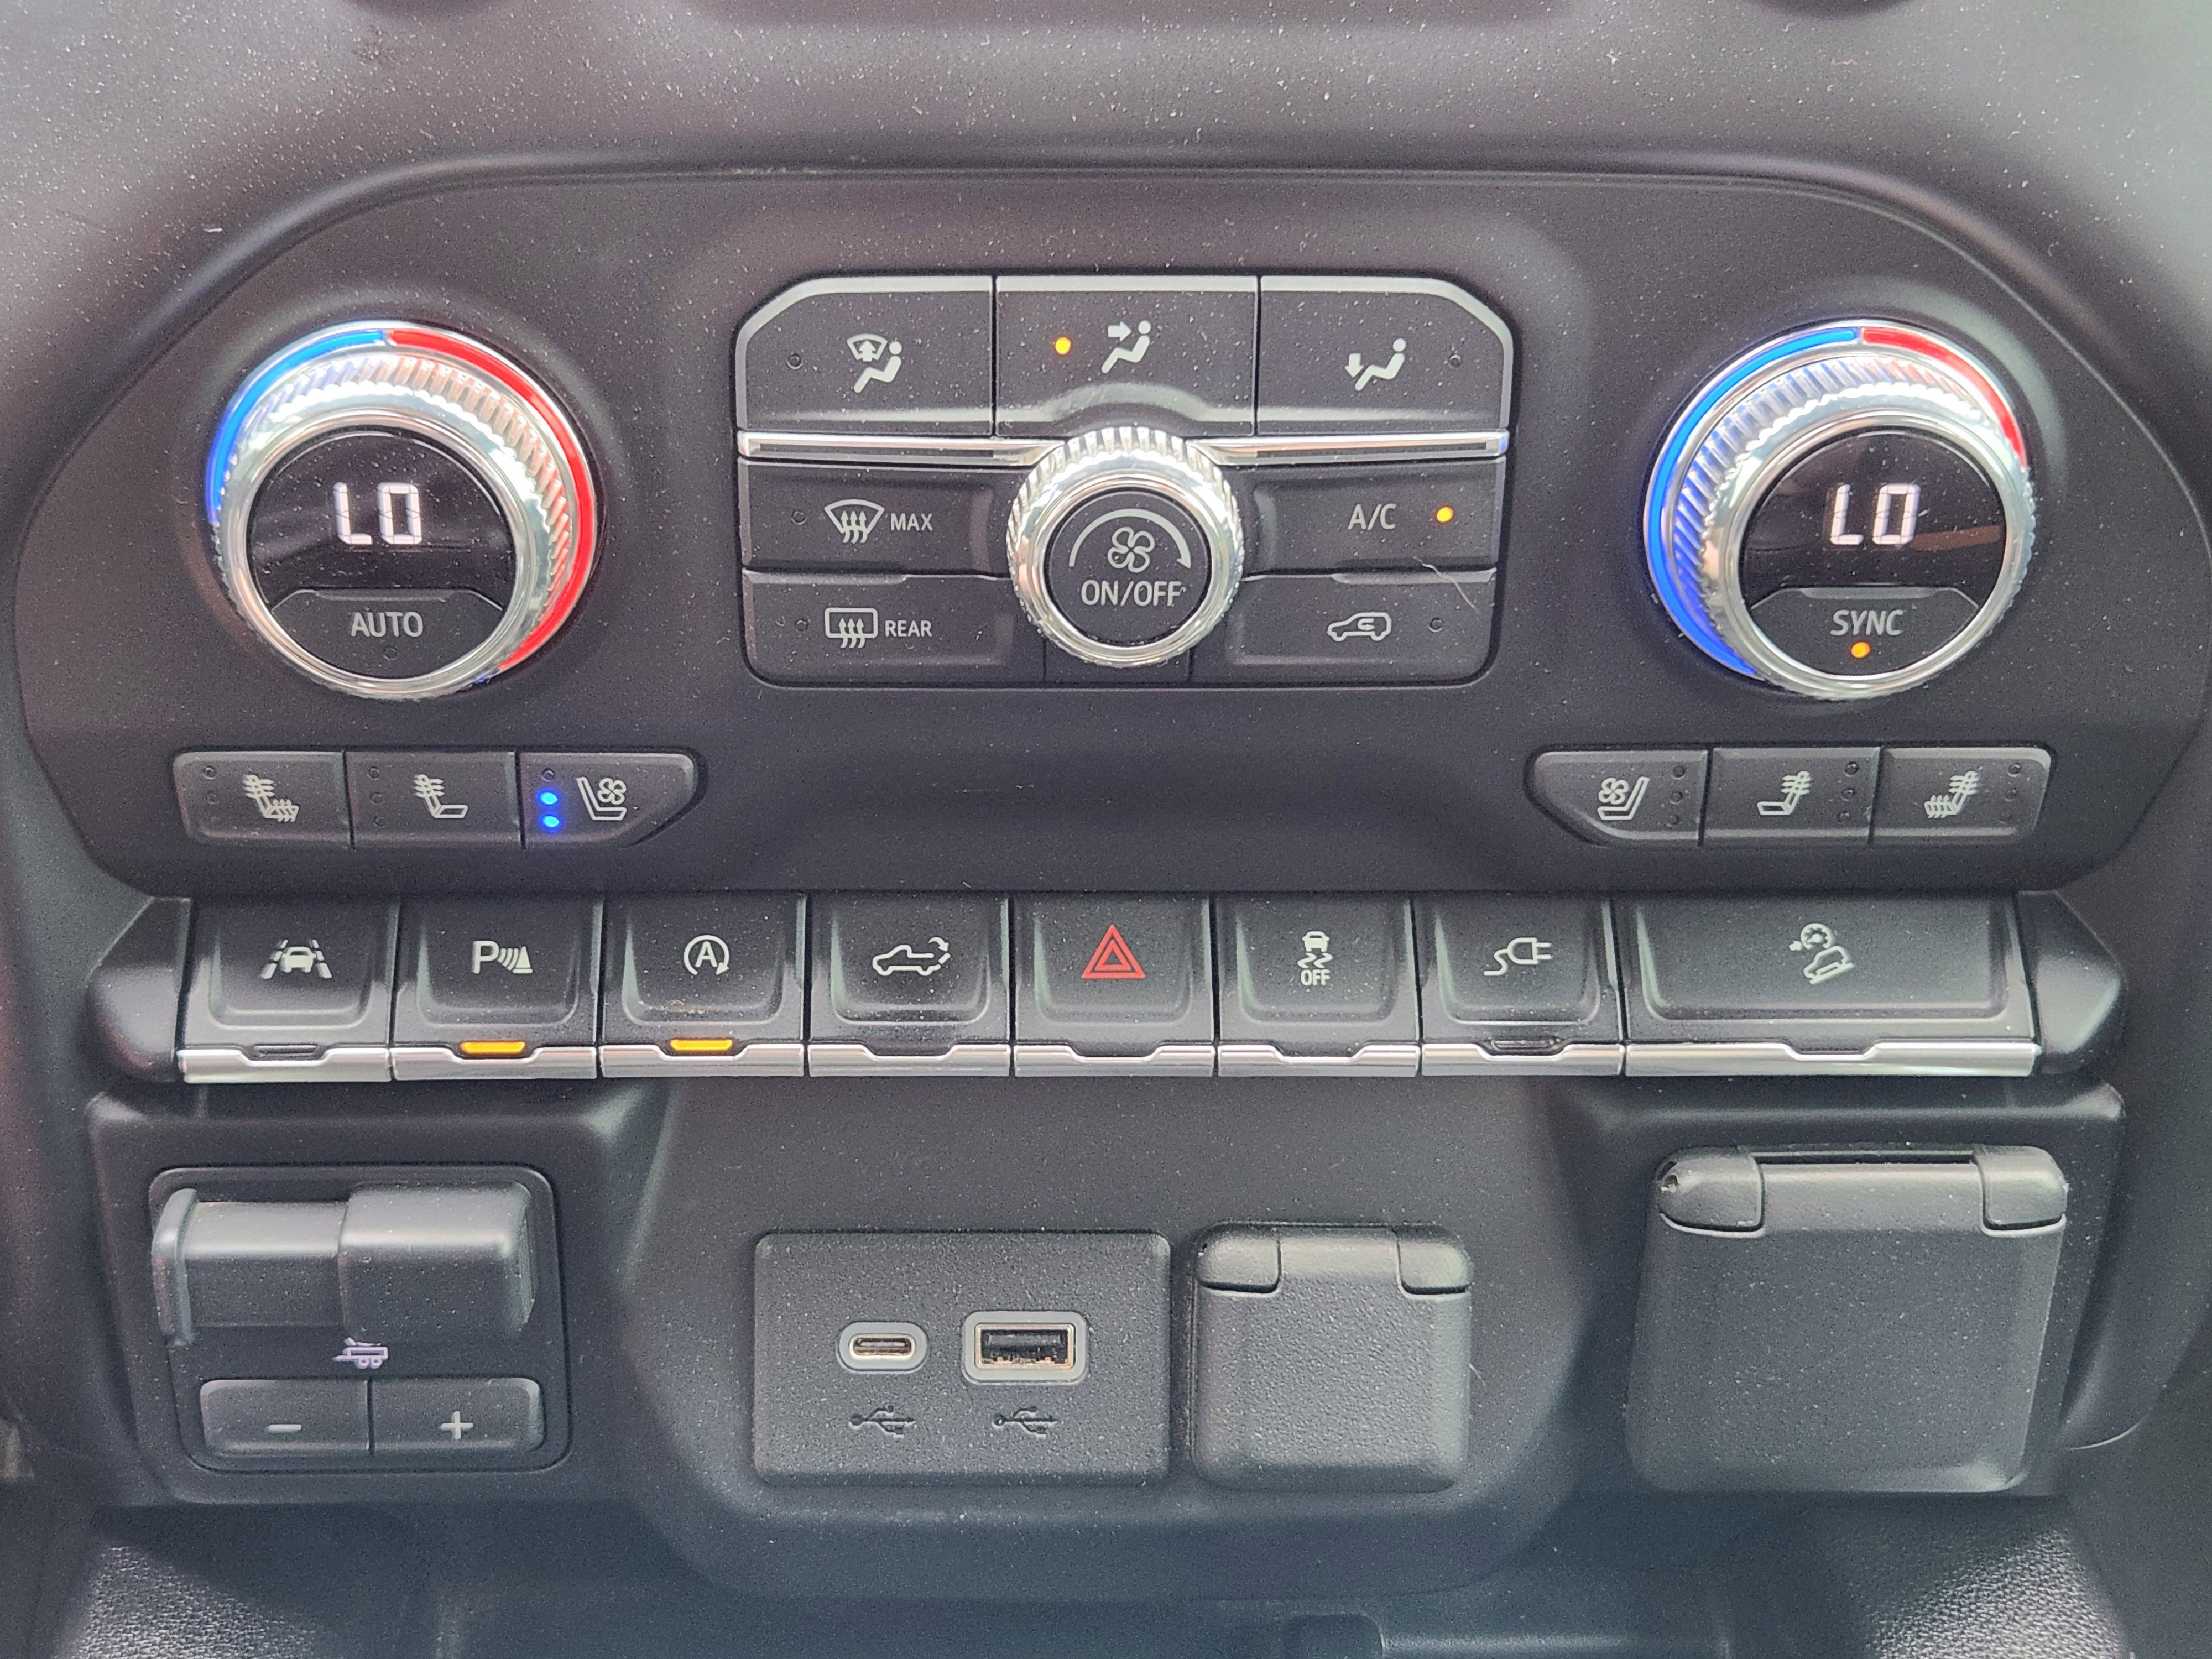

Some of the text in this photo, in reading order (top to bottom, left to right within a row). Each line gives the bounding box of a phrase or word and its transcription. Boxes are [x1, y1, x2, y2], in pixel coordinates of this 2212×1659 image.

[334, 483, 424, 545] LO
[890, 513, 933, 531] MAX
[1348, 504, 1396, 531] A/C
[1829, 484, 1921, 545] LO
[1081, 580, 1182, 607] ON/OFF
[351, 611, 424, 638] AUTO
[885, 620, 932, 637] REAR
[1830, 609, 1903, 637] SYNC
[473, 940, 499, 974] P
[695, 941, 718, 968] A
[1301, 969, 1331, 987] OFF
